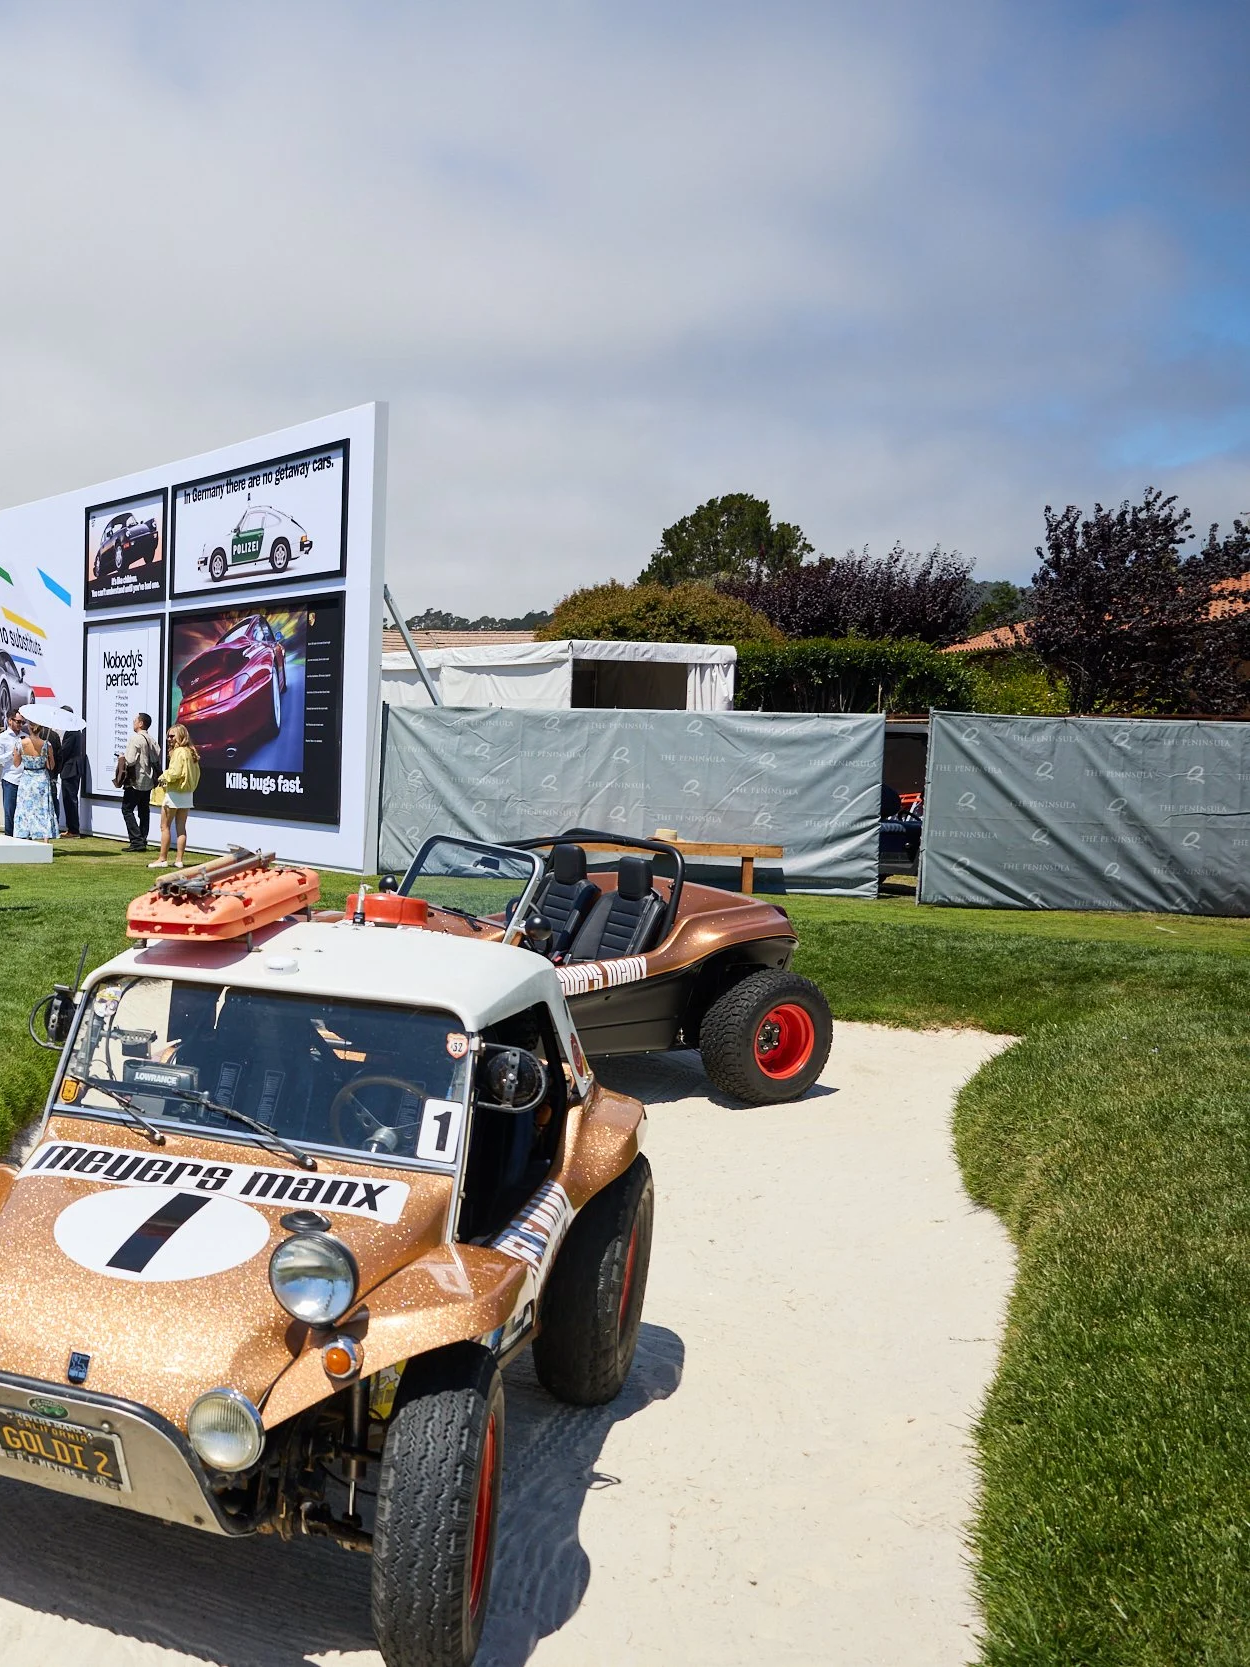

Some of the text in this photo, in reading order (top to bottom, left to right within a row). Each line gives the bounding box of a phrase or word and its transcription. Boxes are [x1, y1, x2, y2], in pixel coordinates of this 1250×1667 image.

[184, 455, 334, 504] In Germany there are no getaway cars.
[233, 540, 259, 556] POLIZEI
[9, 628, 43, 656] substitute.
[103, 649, 143, 671] Nobody's
[609, 722, 654, 730] PENINSULA
[1183, 739, 1230, 747] PENINSULA
[680, 755, 726, 763] PENINSULA
[828, 760, 877, 768] PENINSULA
[1106, 770, 1153, 779] PENINSULA
[225, 772, 304, 795] Kills bugs fast.
[605, 782, 650, 790] PENINSULA
[750, 787, 798, 795] PENINSULA
[1029, 801, 1076, 809] PENINSULA
[1179, 804, 1227, 813] PENINSULA
[930, 829, 998, 839] THE PENINSULA
[1023, 863, 1070, 872] PENINSULA
[134, 1071, 178, 1086] LOWRANCE
[433, 1111, 452, 1152] 1
[31, 1145, 390, 1212] meyers manx
[17, 1419, 88, 1444] CALIFORNIA
[2, 1425, 113, 1477] GOLDI 2
[40, 1459, 78, 1478] MEYERS
